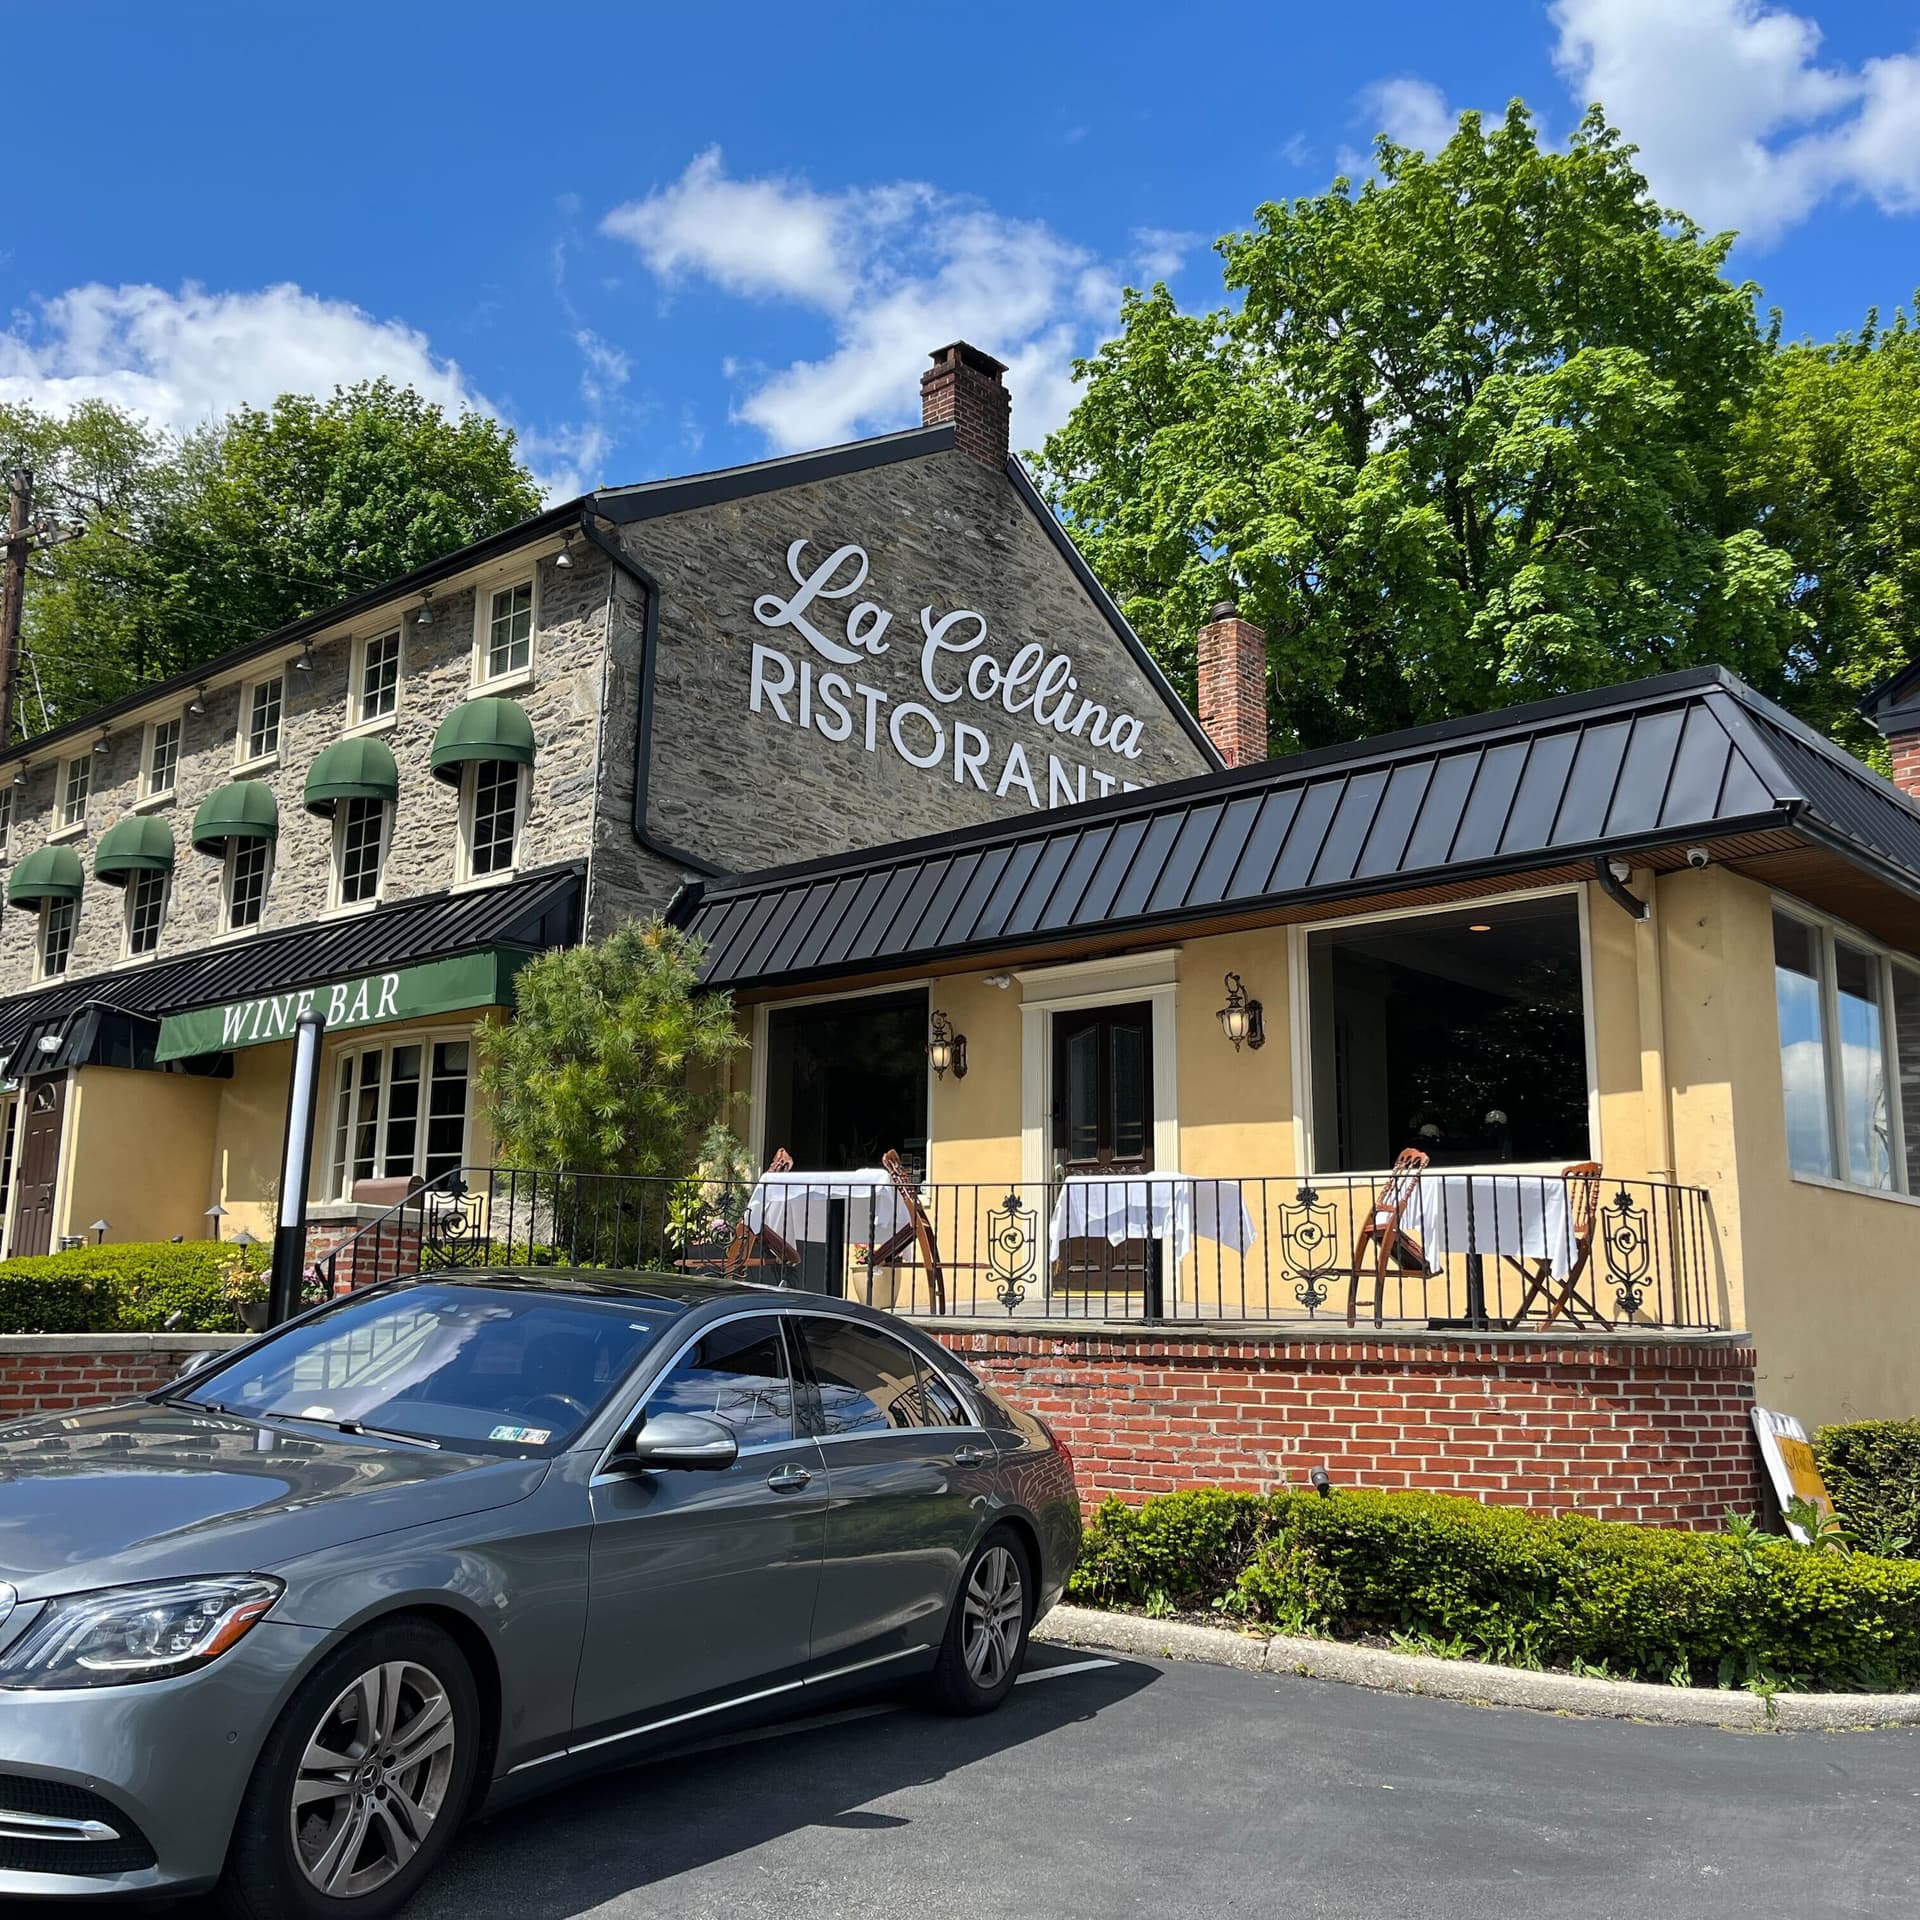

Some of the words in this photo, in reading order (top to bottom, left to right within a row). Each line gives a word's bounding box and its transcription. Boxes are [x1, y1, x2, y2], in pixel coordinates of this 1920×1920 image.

[749, 643, 1144, 809] RISTORANT
[753, 539, 893, 664] La
[920, 605, 1144, 759] Collina
[222, 990, 315, 1045] WINE
[326, 973, 401, 1027] BAR
